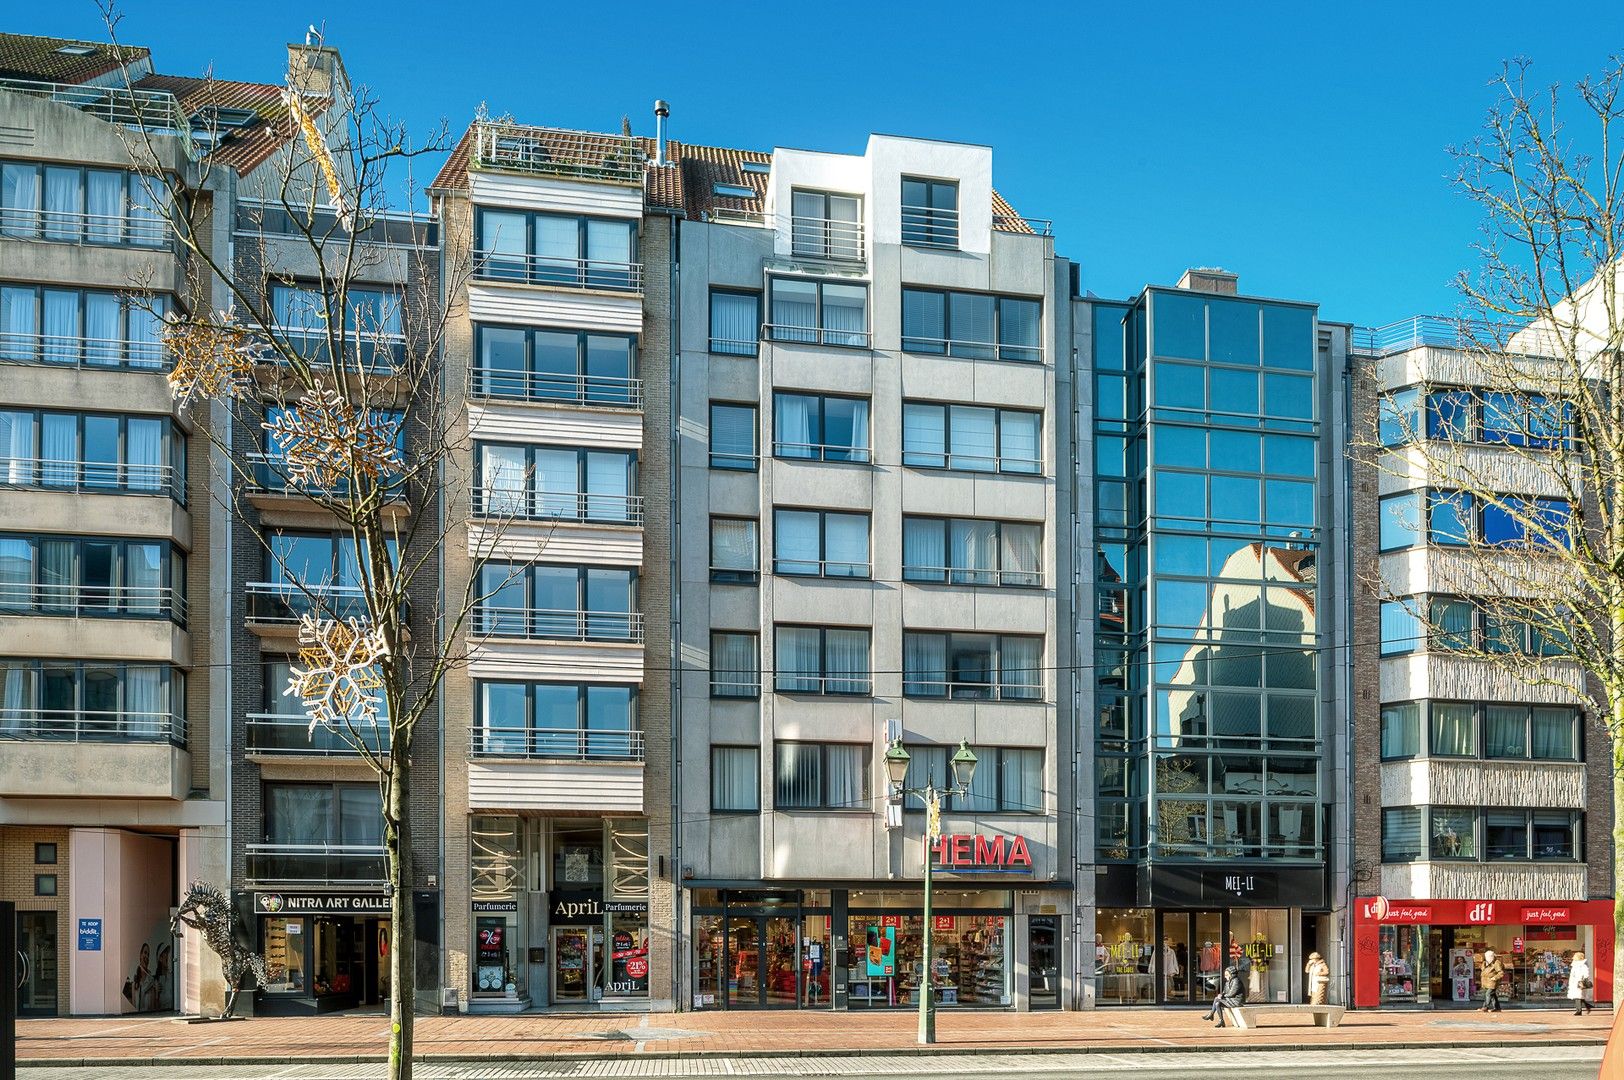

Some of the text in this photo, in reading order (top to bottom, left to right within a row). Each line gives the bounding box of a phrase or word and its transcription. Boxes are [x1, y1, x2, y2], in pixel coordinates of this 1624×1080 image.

[922, 833, 1032, 865] HEMA
[1225, 876, 1254, 890] MEI-LI
[288, 898, 392, 909] NITRA ART GALLE
[474, 903, 516, 911] Parfumerie
[605, 903, 647, 911] Parfumerie
[1526, 910, 1539, 921] just
[628, 961, 646, 970] -21%
